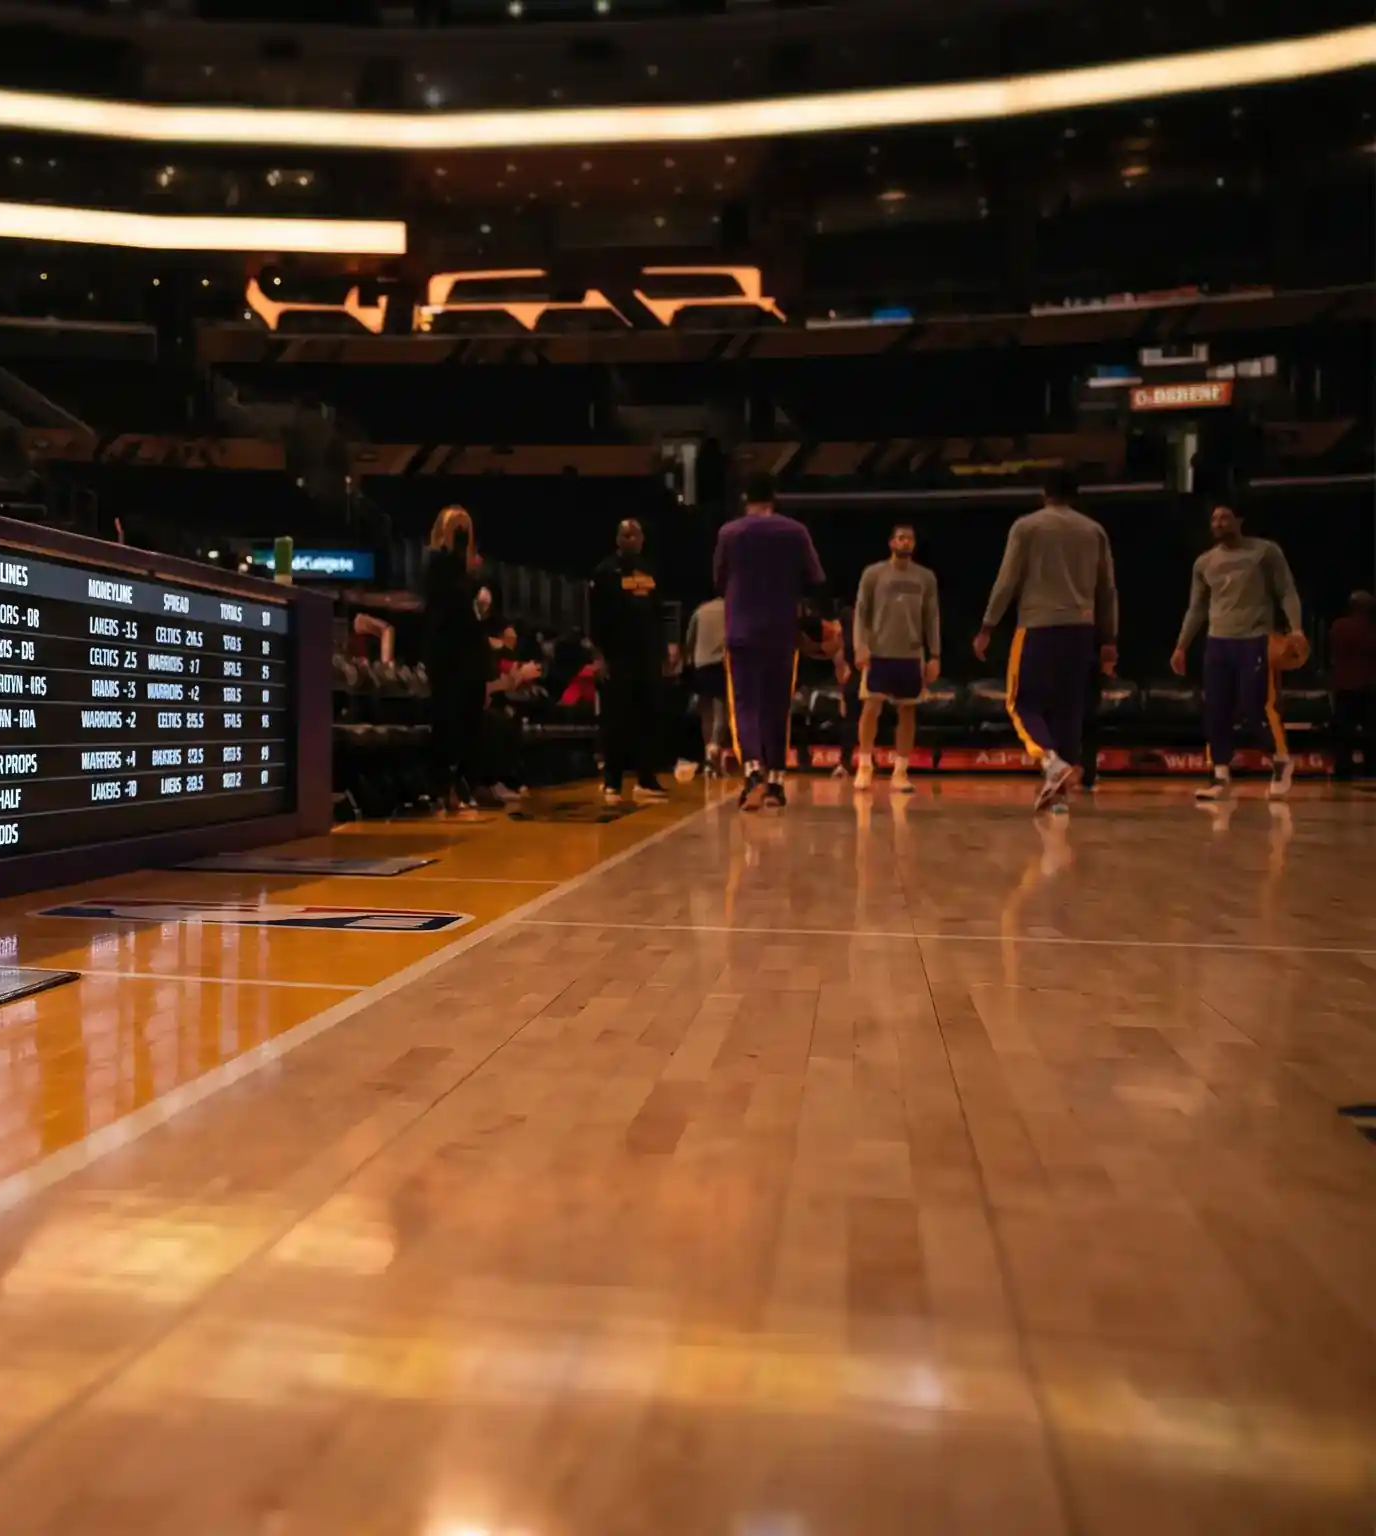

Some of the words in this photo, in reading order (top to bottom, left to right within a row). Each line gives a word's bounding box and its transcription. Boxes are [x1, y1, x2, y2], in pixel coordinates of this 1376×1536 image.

[0, 562, 29, 587] LINES
[87, 578, 133, 605] MONEYLINE
[89, 647, 119, 667] CELTICS
[5, 753, 38, 775] PROPS
